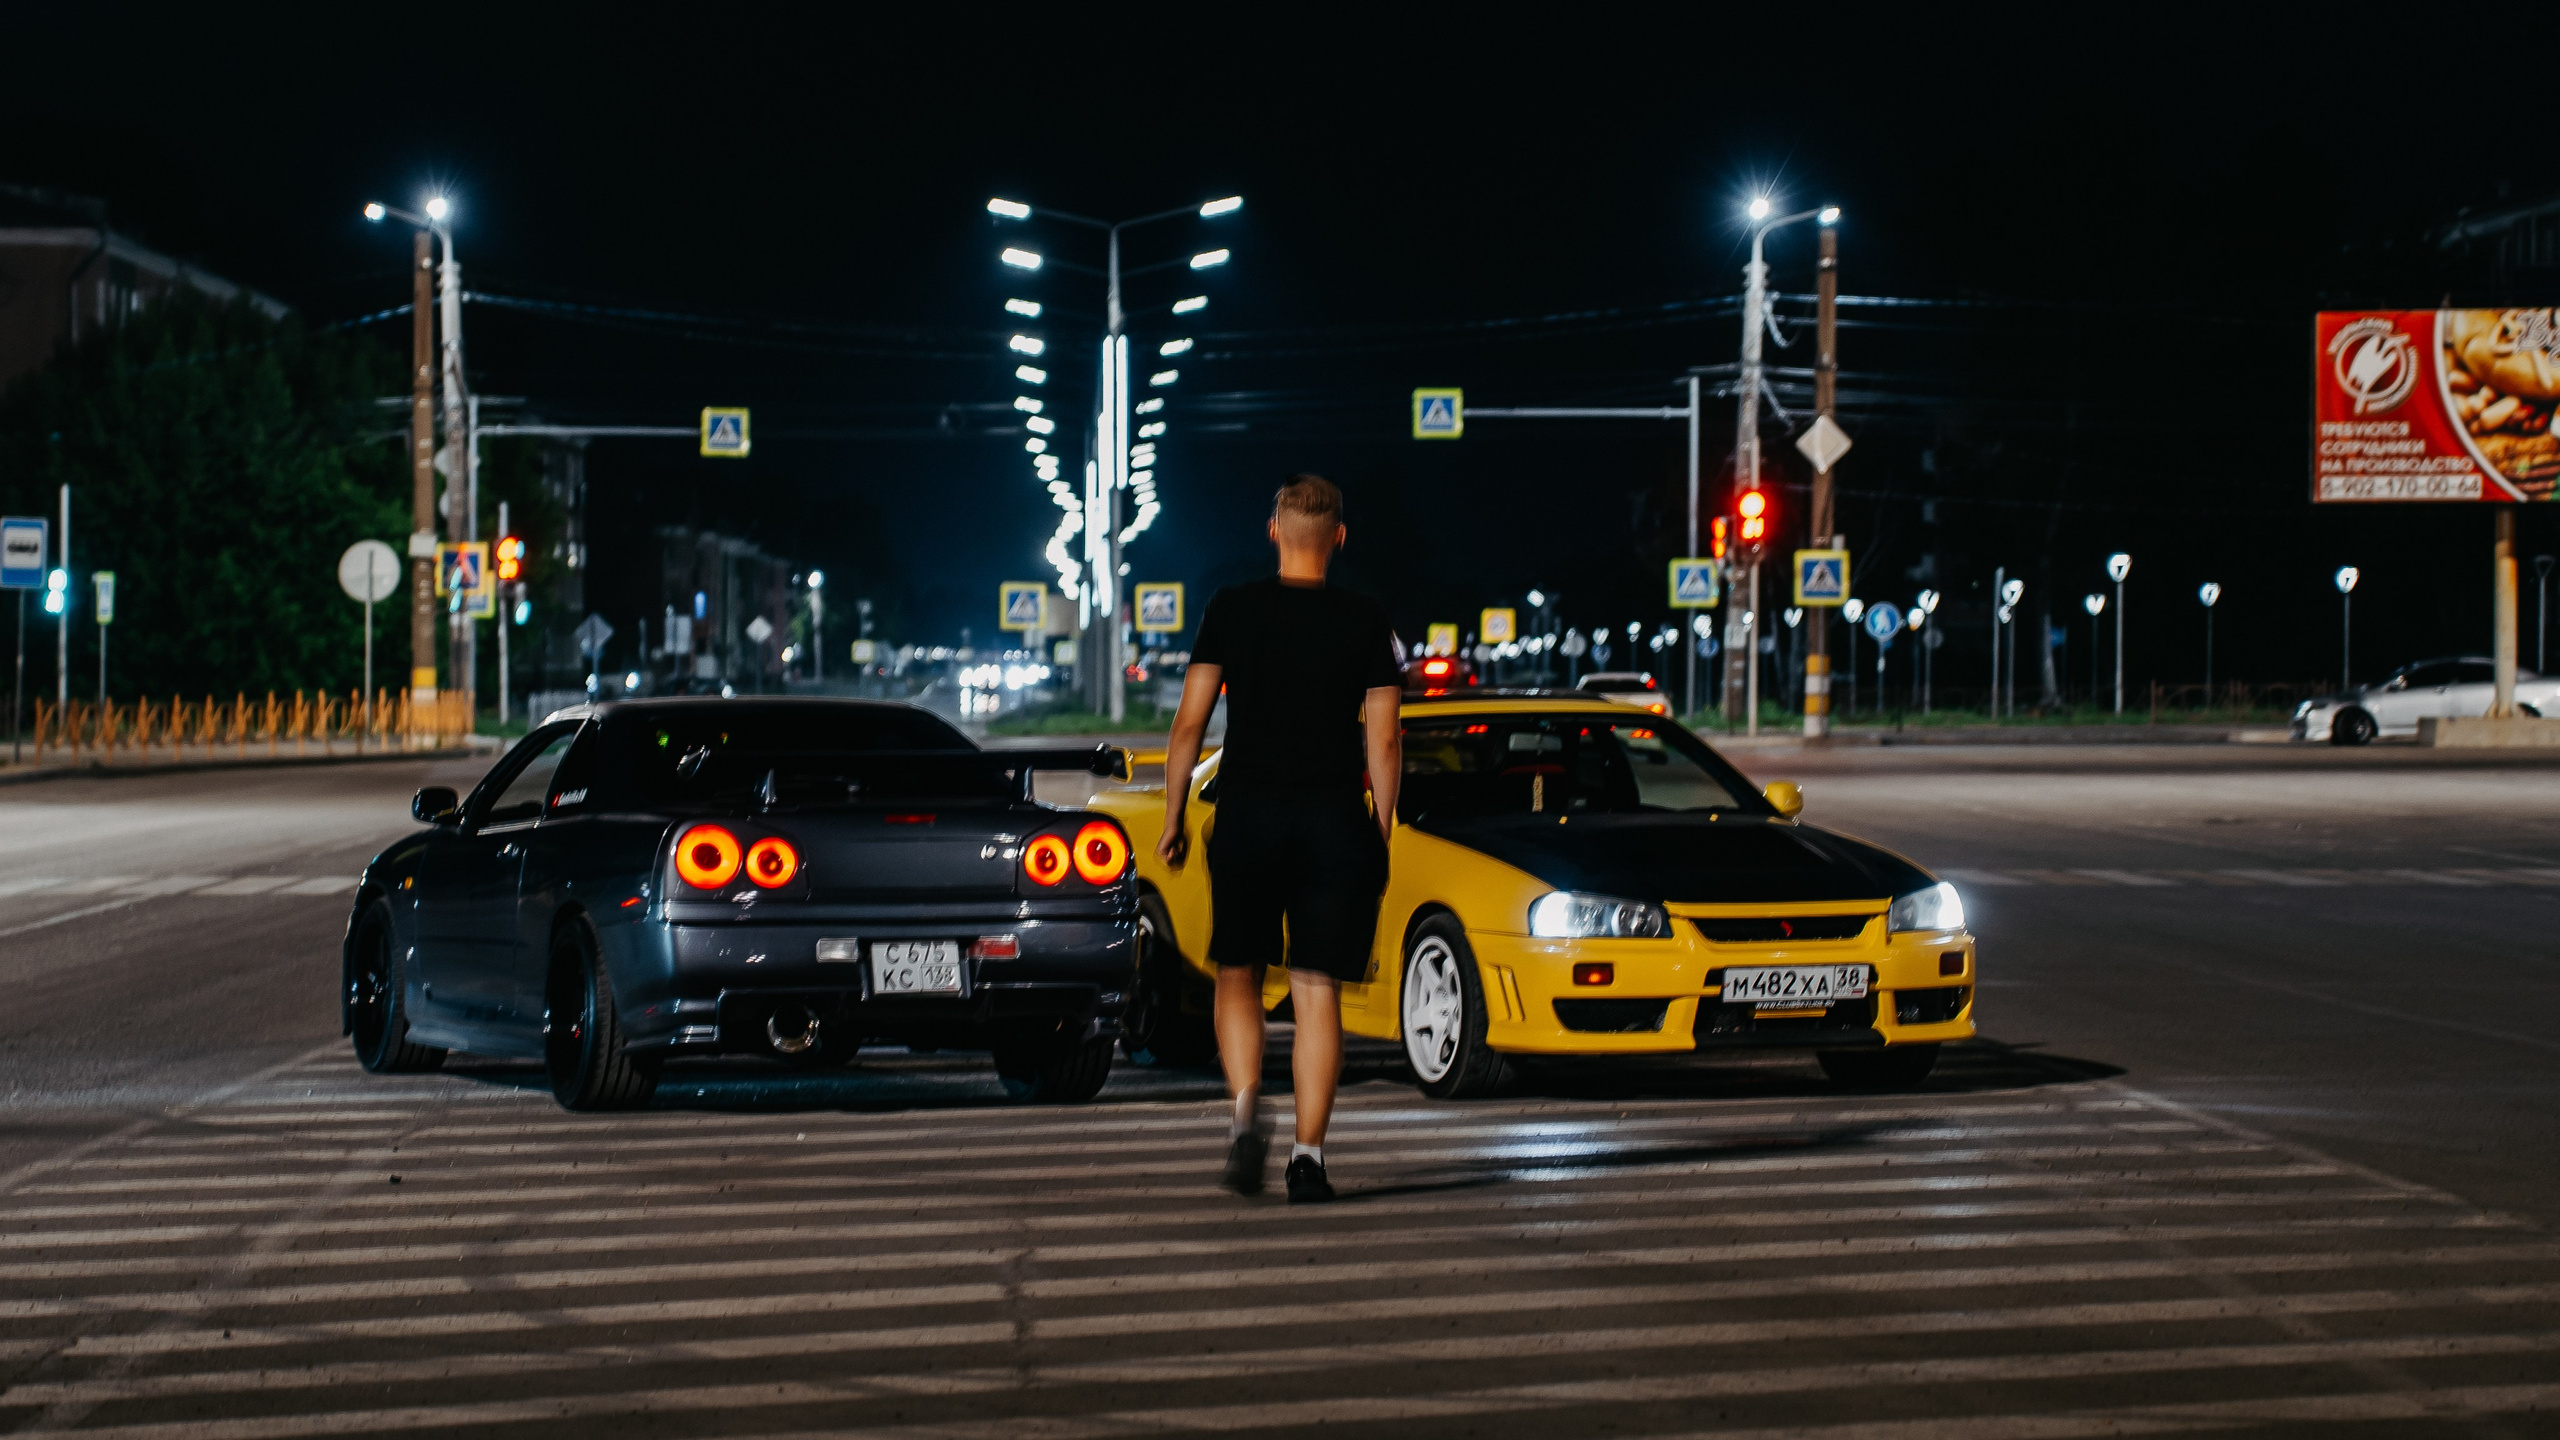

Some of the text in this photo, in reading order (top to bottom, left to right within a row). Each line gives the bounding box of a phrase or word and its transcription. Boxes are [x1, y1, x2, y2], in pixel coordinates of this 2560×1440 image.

[2321, 421, 2410, 437] ТРЕБУЮТСЯ
[2320, 439, 2426, 455] СОТРУДНИКИ
[2321, 457, 2475, 472] НА ПРОИЗВОДСТВО
[1836, 967, 1860, 987] 38
